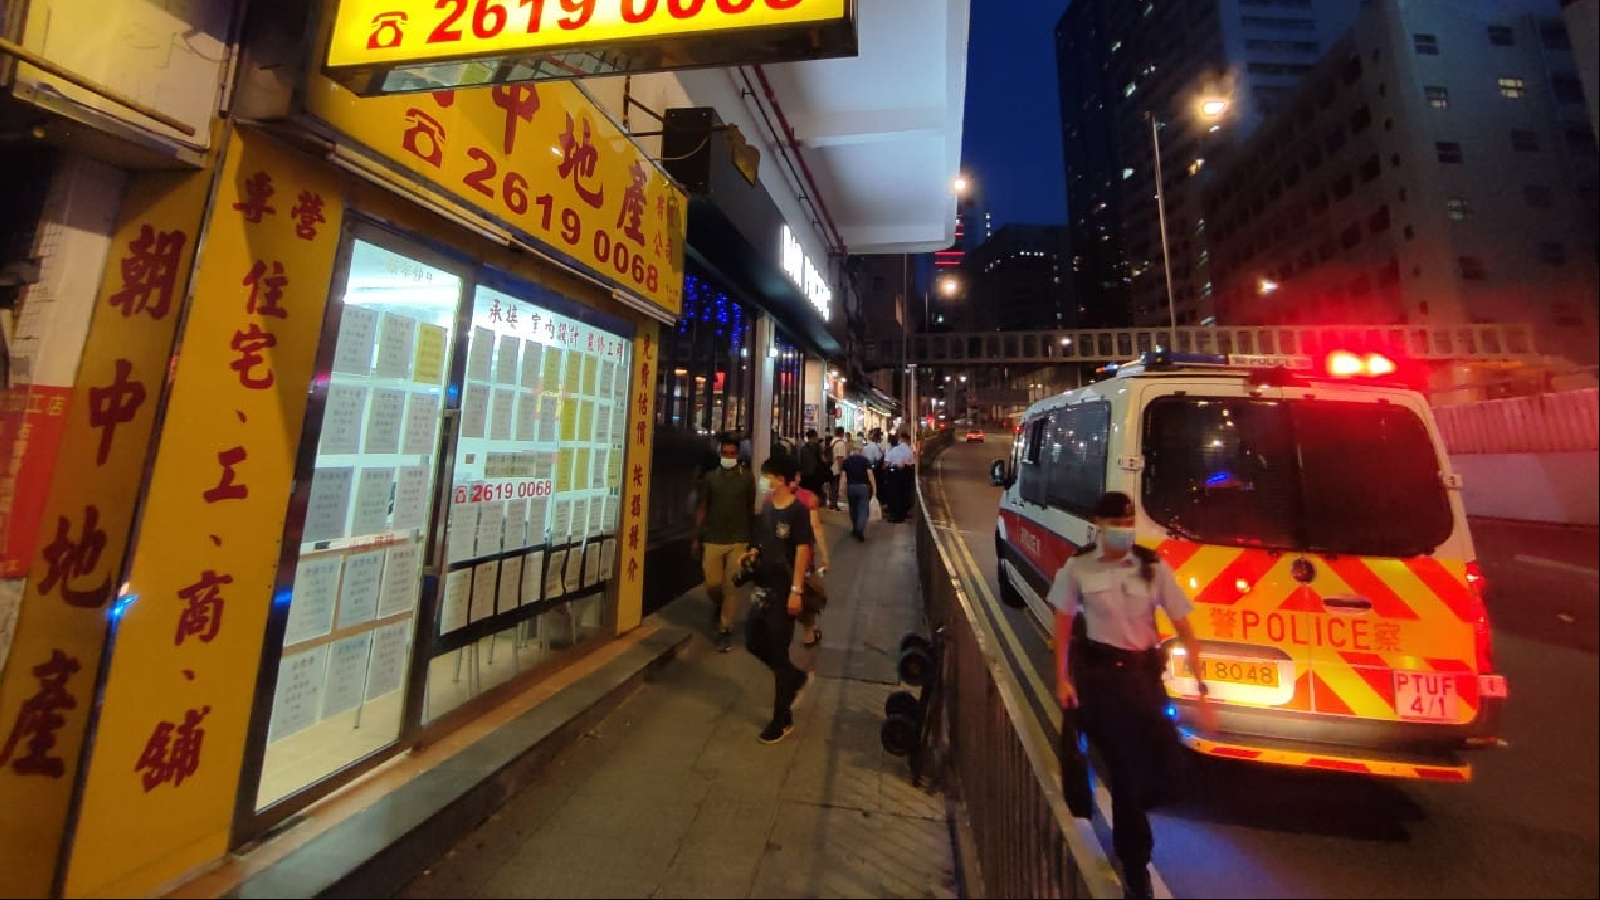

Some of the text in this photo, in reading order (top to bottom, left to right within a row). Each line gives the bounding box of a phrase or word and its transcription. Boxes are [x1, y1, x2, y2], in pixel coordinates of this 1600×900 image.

[425, 0, 597, 43] 2619
[430, 79, 648, 248] 中地產
[233, 171, 326, 241] 專營
[462, 146, 659, 293] 2619 0068
[0, 222, 187, 780] 朝中地產
[471, 480, 552, 504] 2619 0068
[1240, 610, 1372, 651] POLICE
[1214, 661, 1274, 685] 8048
[1397, 673, 1453, 696] PTUF
[1409, 693, 1447, 716] 4/1
